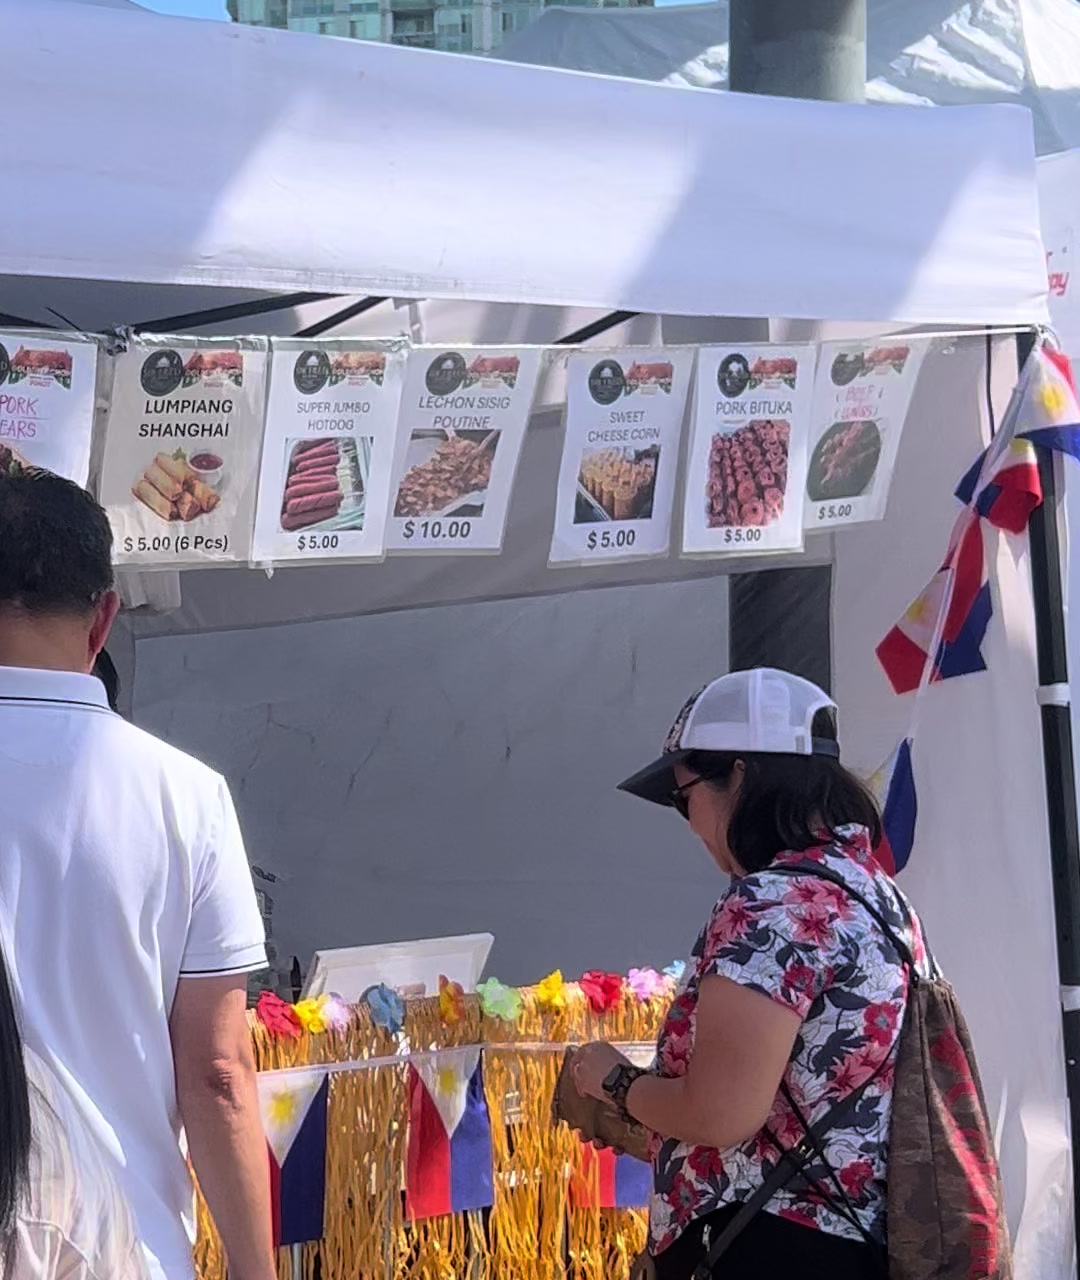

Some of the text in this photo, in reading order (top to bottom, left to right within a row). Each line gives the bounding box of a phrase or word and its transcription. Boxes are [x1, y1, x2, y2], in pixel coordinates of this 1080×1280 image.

[144, 398, 234, 415] LUMPIANG
[296, 401, 371, 414] SUPER JUMBO
[418, 395, 511, 410] LECHON SISIG
[715, 400, 793, 416] PORK BITUKA
[307, 418, 355, 431] HOTDOG
[432, 415, 491, 428] POUTINE
[608, 410, 646, 424] SWEET
[138, 422, 230, 438] SHANGHAI
[587, 427, 661, 443] CHEESE CORN
[827, 503, 853, 519] 5.00
[420, 520, 472, 540] 10.00
[733, 527, 762, 544] 5.00
[123, 534, 229, 553] $ 5.00 (6 Pcs)
[308, 534, 340, 550] 5.00
[600, 528, 636, 549] 5.00
